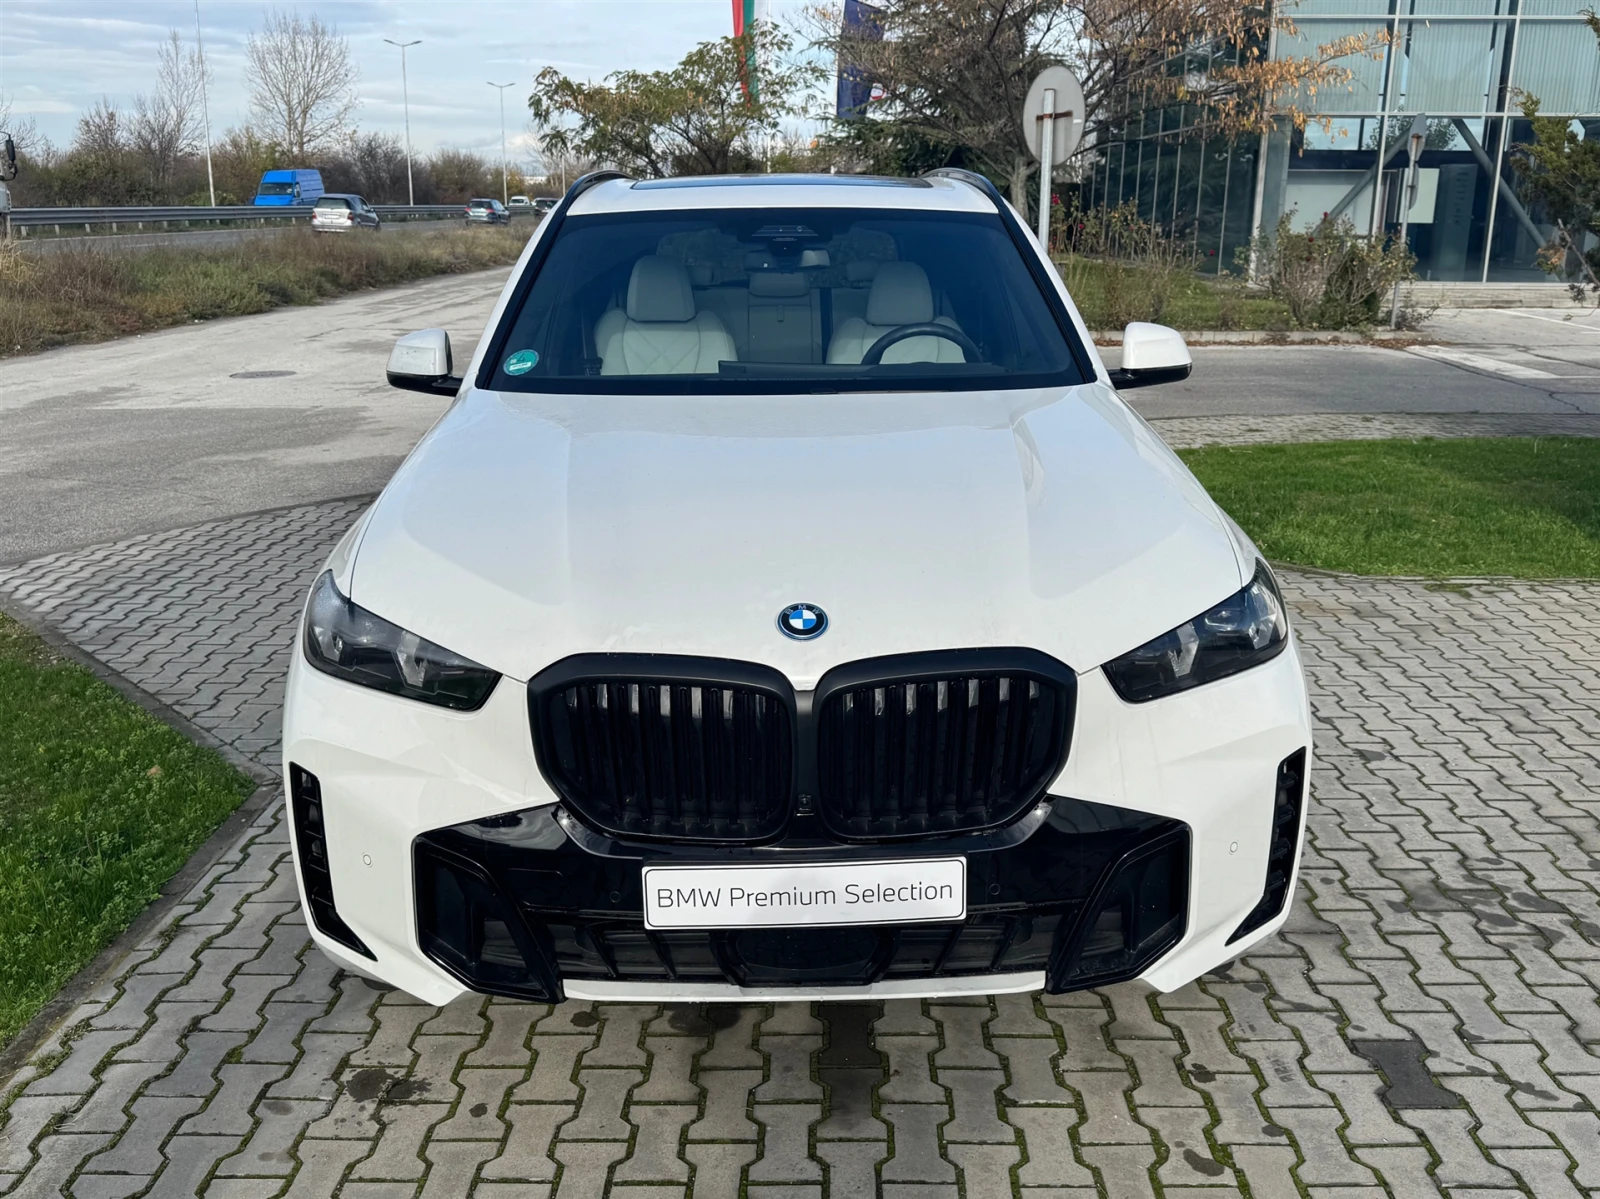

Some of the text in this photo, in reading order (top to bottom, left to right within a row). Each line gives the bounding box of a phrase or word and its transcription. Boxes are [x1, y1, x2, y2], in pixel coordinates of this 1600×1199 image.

[785, 604, 821, 614] BMW
[657, 881, 953, 908] BMW Premium Selection
